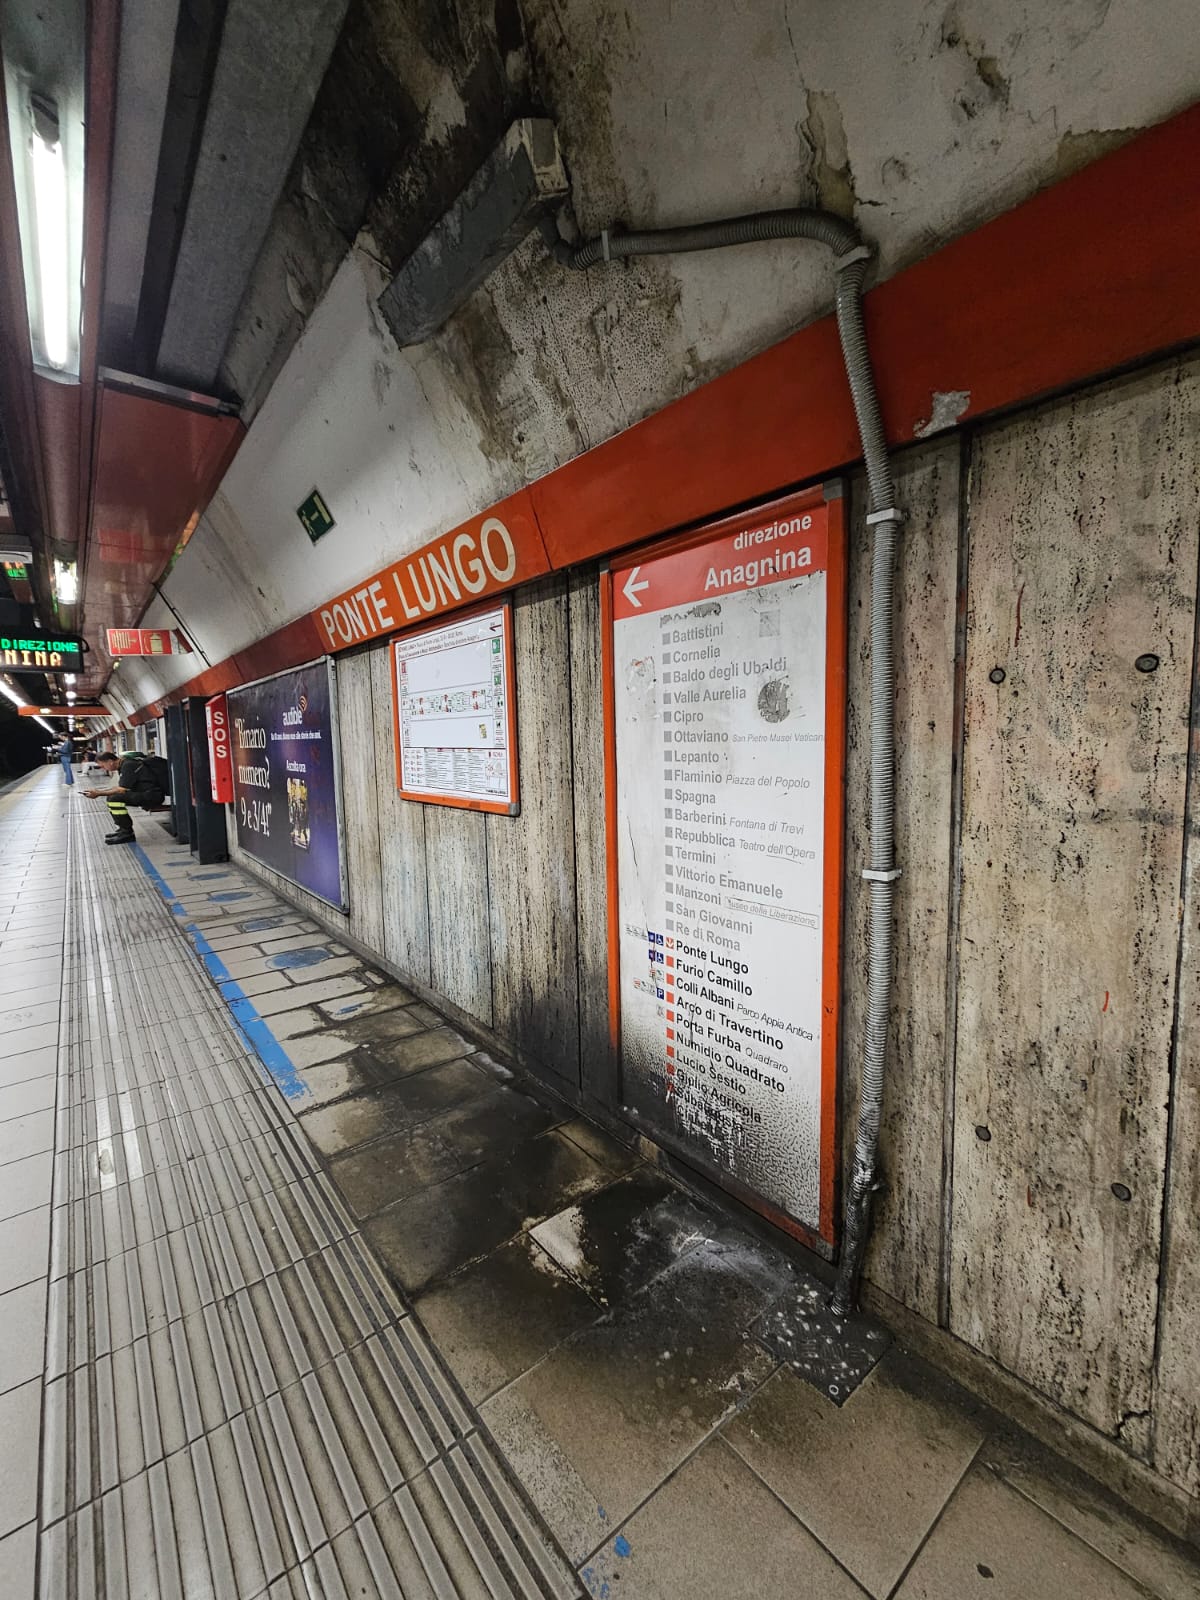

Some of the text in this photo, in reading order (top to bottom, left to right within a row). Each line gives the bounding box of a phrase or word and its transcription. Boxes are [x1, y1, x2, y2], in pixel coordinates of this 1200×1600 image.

[734, 514, 812, 551] direzione
[320, 517, 516, 647] PONTE LUNGO
[704, 546, 812, 591] Anagnina
[0, 639, 79, 653] DIREZIONE
[672, 622, 724, 643] Battistini
[0, 650, 61, 667] NINA
[673, 645, 721, 663] Cornelia
[673, 657, 787, 683] Baldo degli Ubaldi
[674, 686, 746, 703] Valle Aurelia
[282, 706, 303, 727] audible
[674, 710, 704, 725] Cipro
[214, 711, 227, 758] SOS
[674, 730, 729, 743] Ottaviano
[794, 732, 824, 742] Vatican
[674, 749, 720, 763] Lepanto
[238, 756, 270, 789] numero?
[674, 769, 810, 790] Flaminio Piazza del Popolo
[241, 797, 247, 827] 9
[675, 789, 716, 806] Spagna
[674, 808, 805, 835] Barberini Fontana di Trevi
[675, 827, 736, 848] Repubblica
[739, 839, 766, 852] Teatro
[675, 846, 716, 864] Termini
[675, 865, 783, 899] Vittorio Emanuele
[675, 883, 722, 905] Manzoni
[675, 903, 753, 935] San Giovanni
[676, 921, 740, 951] Re di Roma
[676, 940, 749, 974] Ponte Lungo
[676, 958, 753, 996] Furio Camillo
[676, 977, 698, 996] Colli
[700, 986, 735, 1010] Albani
[760, 1013, 785, 1030] Appia
[785, 1023, 813, 1041] Antica
[677, 996, 784, 1050] Arco di Travertino
[676, 1013, 789, 1074] Porta Furba Quadraro
[676, 1031, 785, 1093] Numidio Quadrato
[676, 1049, 746, 1095] Lucio Sestio
[711, 1087, 762, 1124] Agricola
